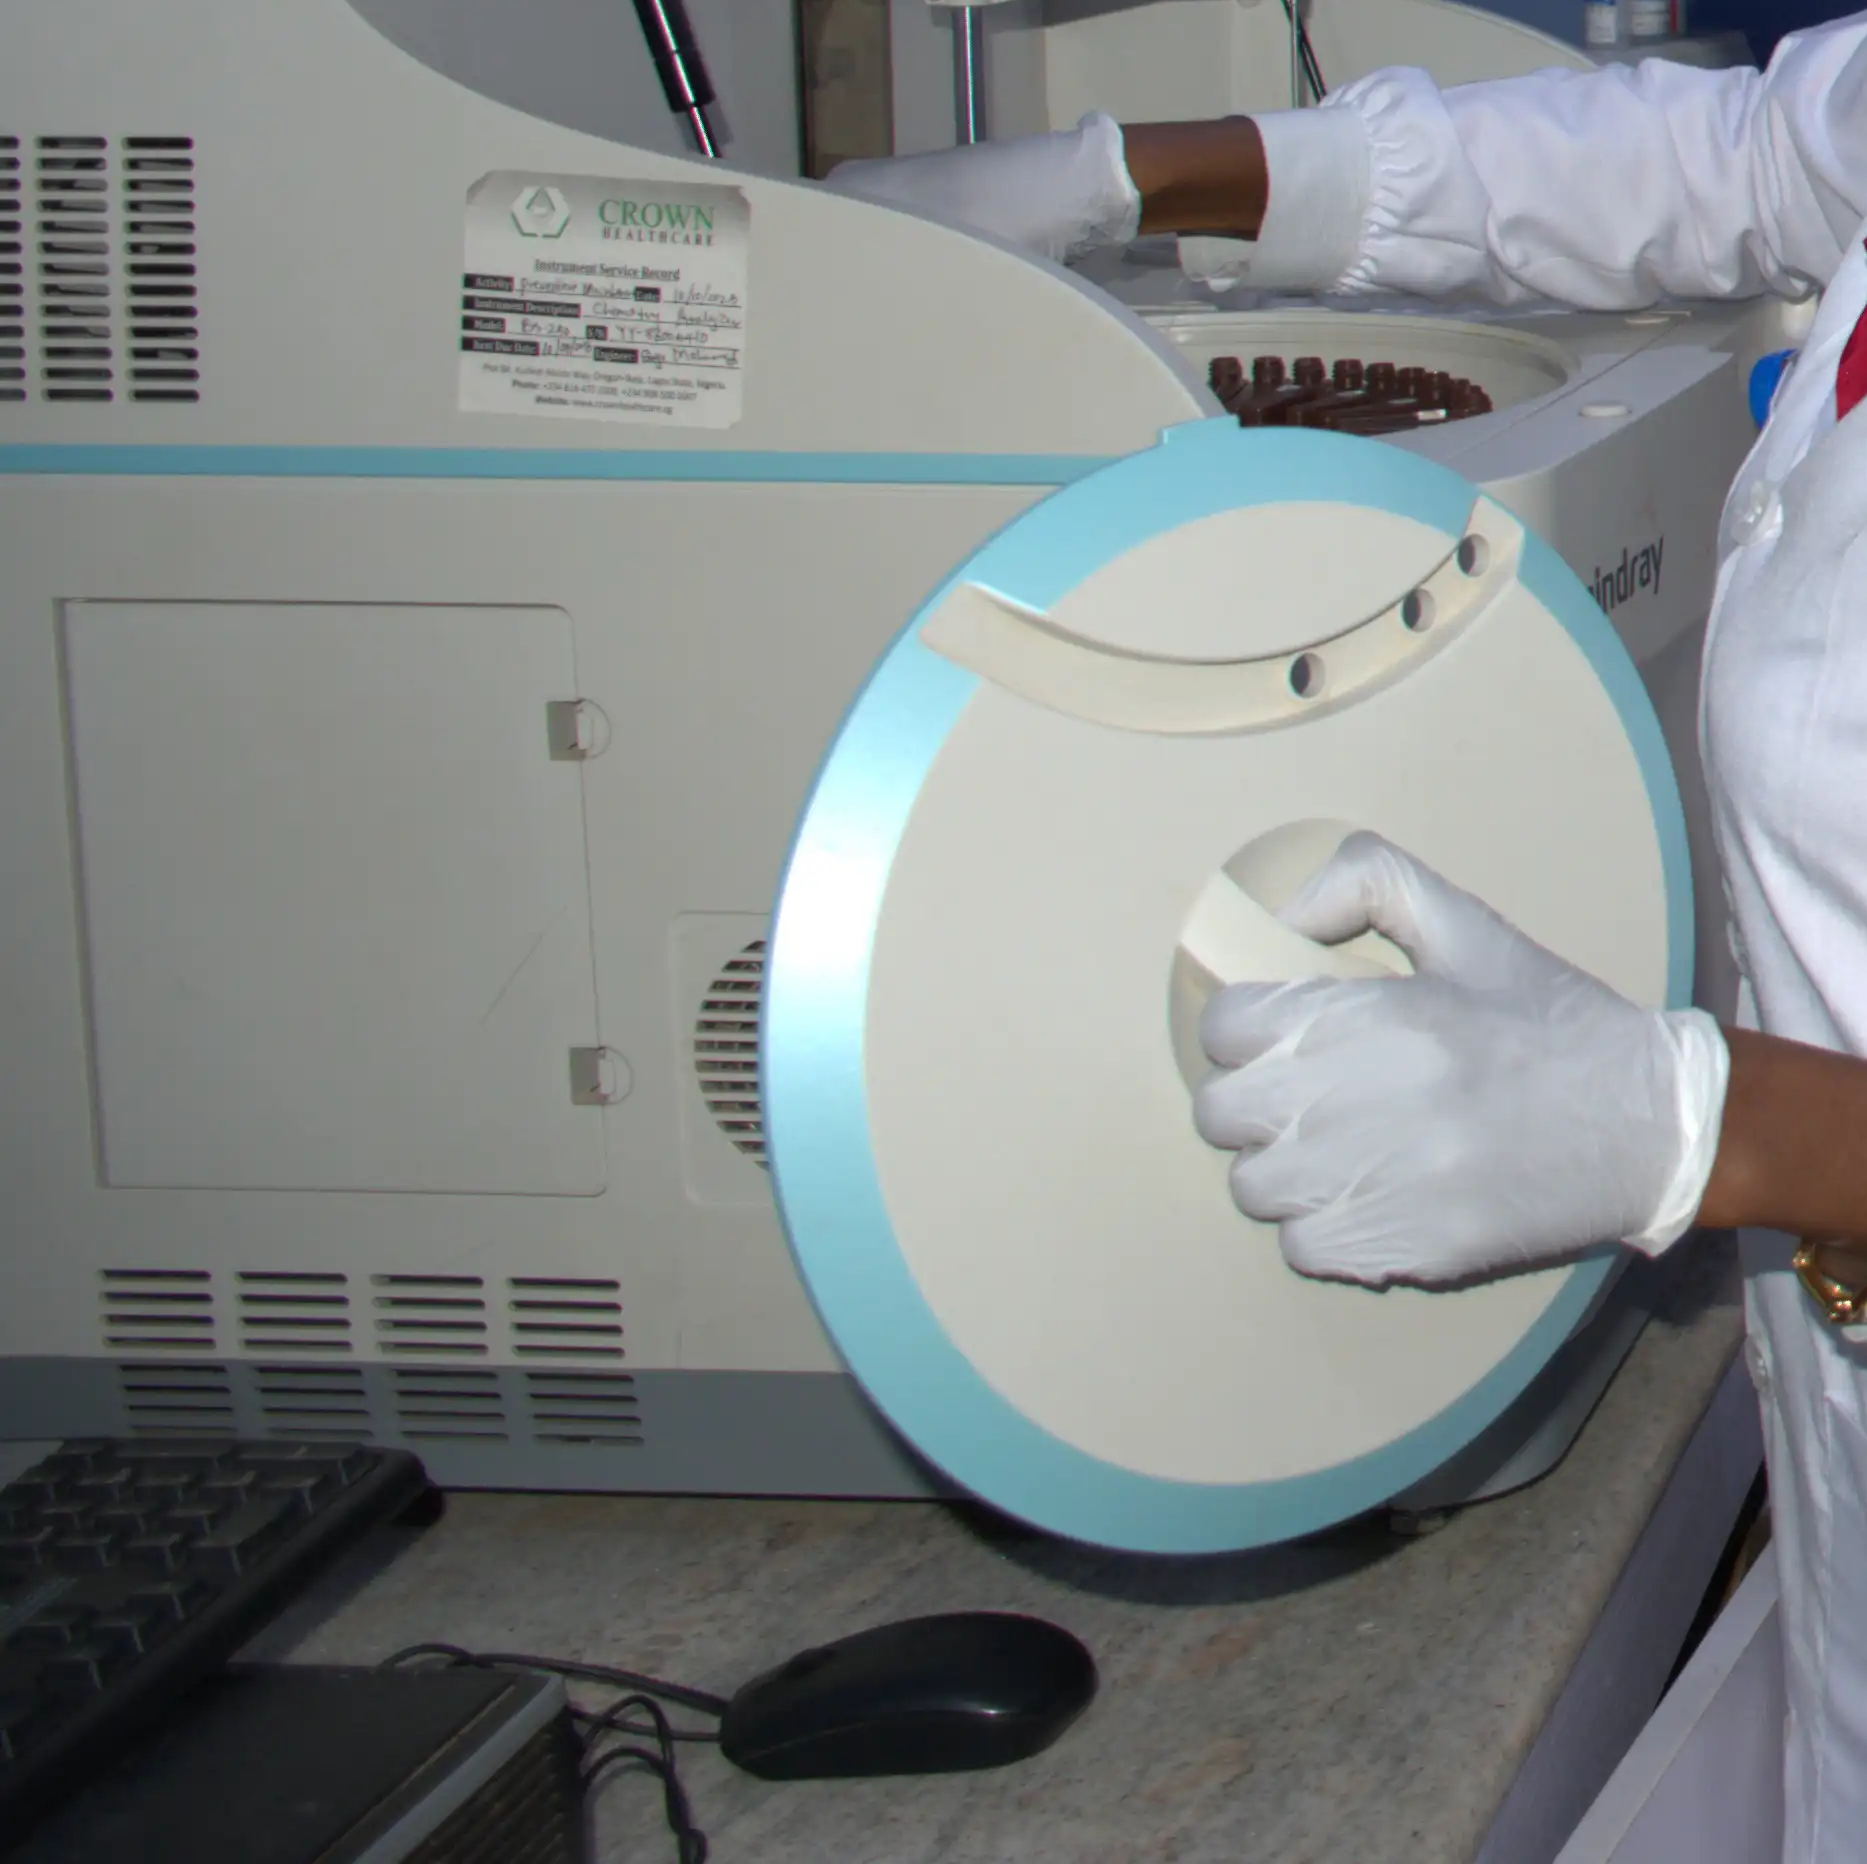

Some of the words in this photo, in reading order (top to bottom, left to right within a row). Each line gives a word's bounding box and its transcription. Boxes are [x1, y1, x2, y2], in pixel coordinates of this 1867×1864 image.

[598, 198, 715, 231] CROWN
[602, 226, 715, 247] HEALTHCARE
[535, 258, 597, 275] Instrument
[600, 262, 640, 279] Service
[642, 265, 680, 282] Record
[1588, 533, 1664, 615] indray
